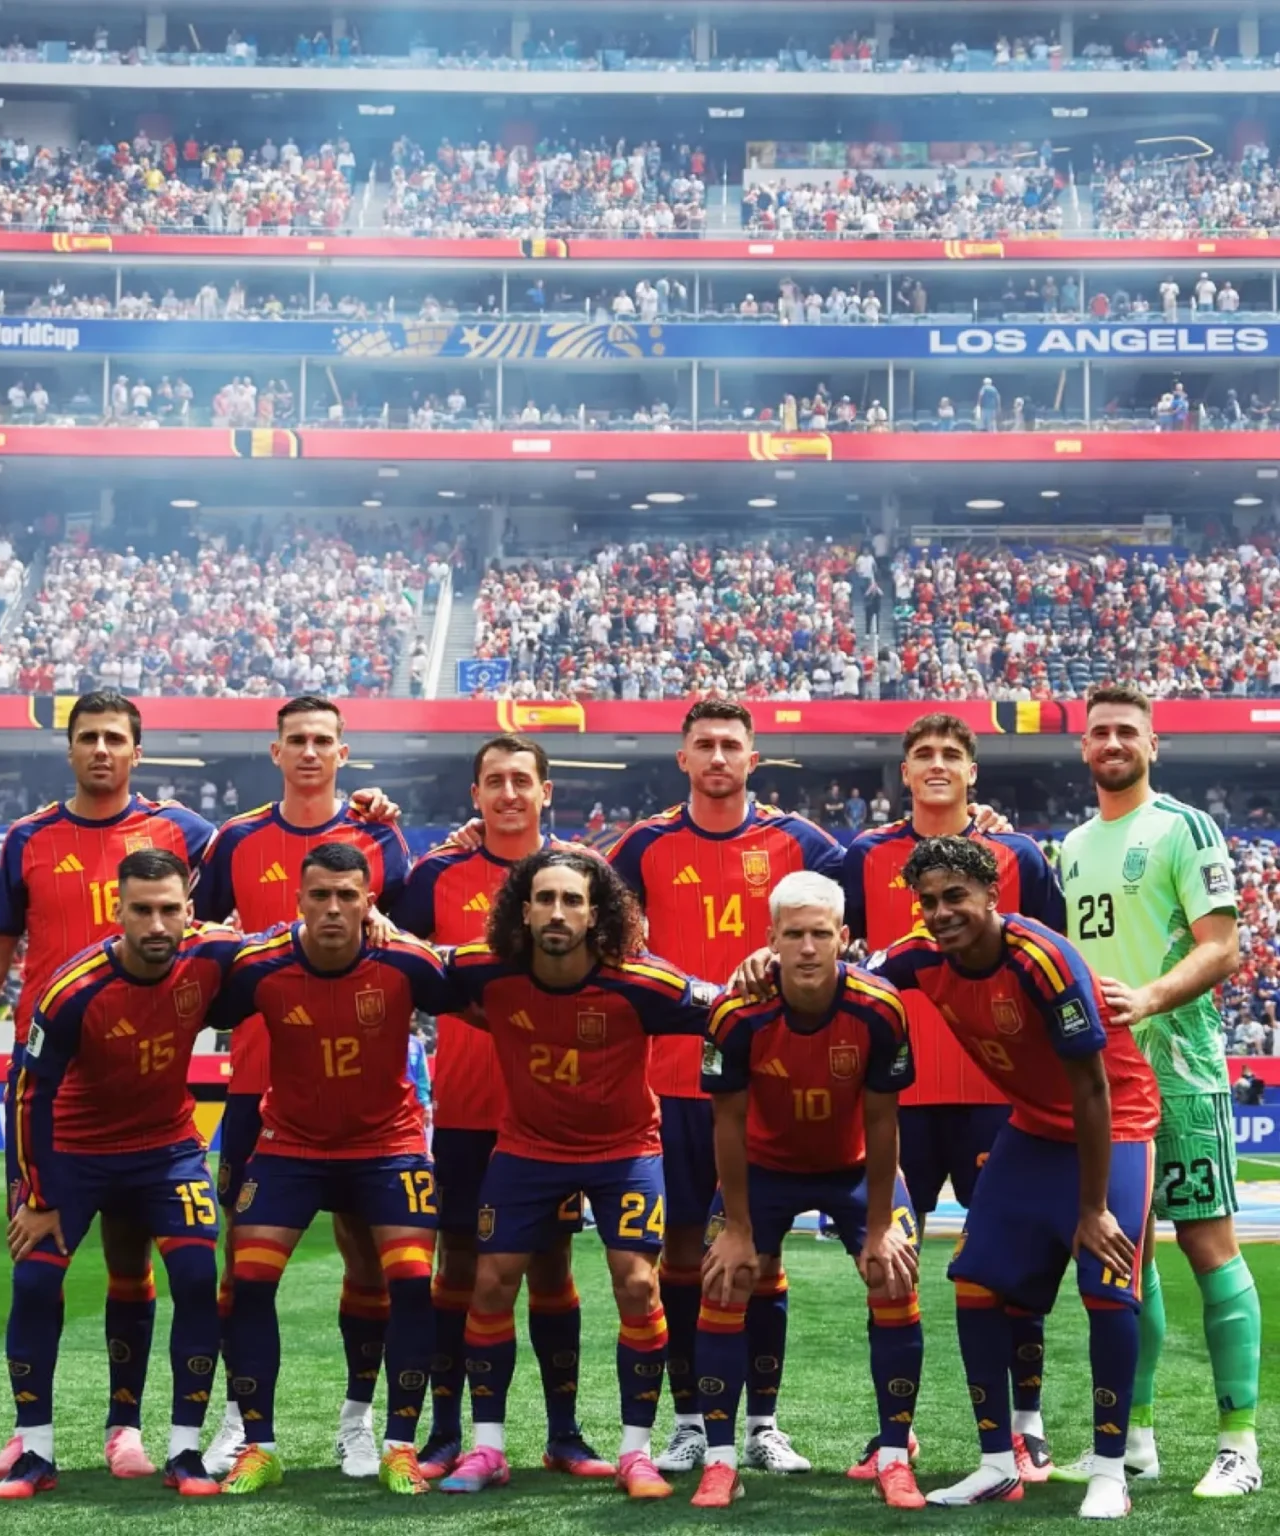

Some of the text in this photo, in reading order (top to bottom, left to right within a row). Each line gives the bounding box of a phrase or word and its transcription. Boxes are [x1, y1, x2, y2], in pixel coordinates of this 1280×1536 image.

[929, 328, 1269, 354] LOS ANGELES
[703, 893, 745, 940] 14
[1078, 893, 1115, 940] 23
[138, 1031, 176, 1075] 15
[321, 1037, 361, 1079] 12
[530, 1044, 580, 1086] 24
[974, 1037, 1014, 1071] 19
[792, 1088, 831, 1121] 10
[176, 1180, 216, 1227] 15
[399, 1170, 438, 1214] 12
[1163, 1159, 1217, 1206] 23
[619, 1192, 666, 1239] 24
